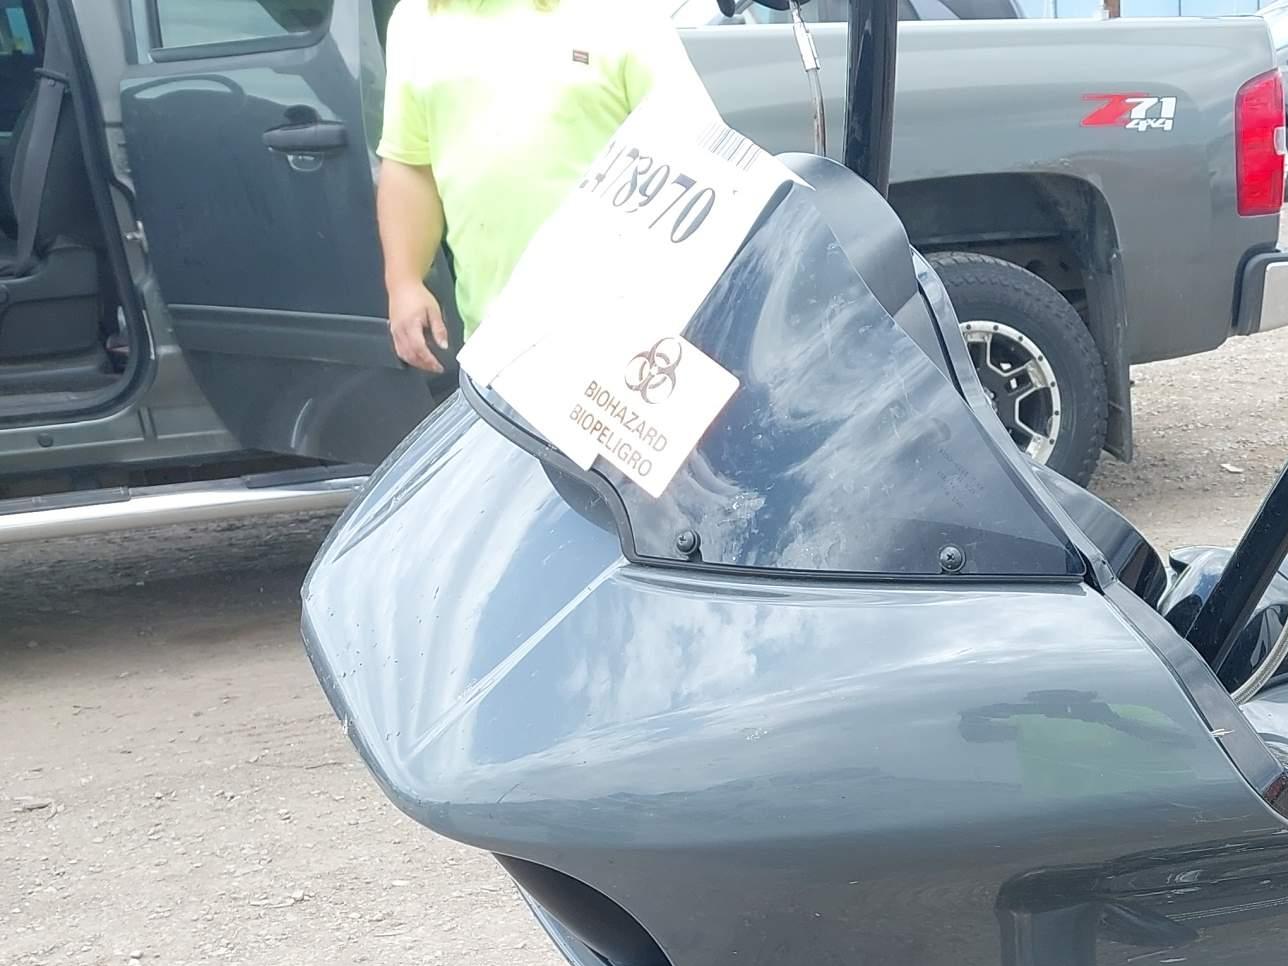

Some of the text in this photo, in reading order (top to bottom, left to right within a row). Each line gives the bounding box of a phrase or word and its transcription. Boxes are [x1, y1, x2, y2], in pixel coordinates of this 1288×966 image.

[1080, 92, 1177, 127] Z71
[569, 403, 653, 477] BIOPELIGRO
[584, 380, 668, 452] BIOHAZARD
